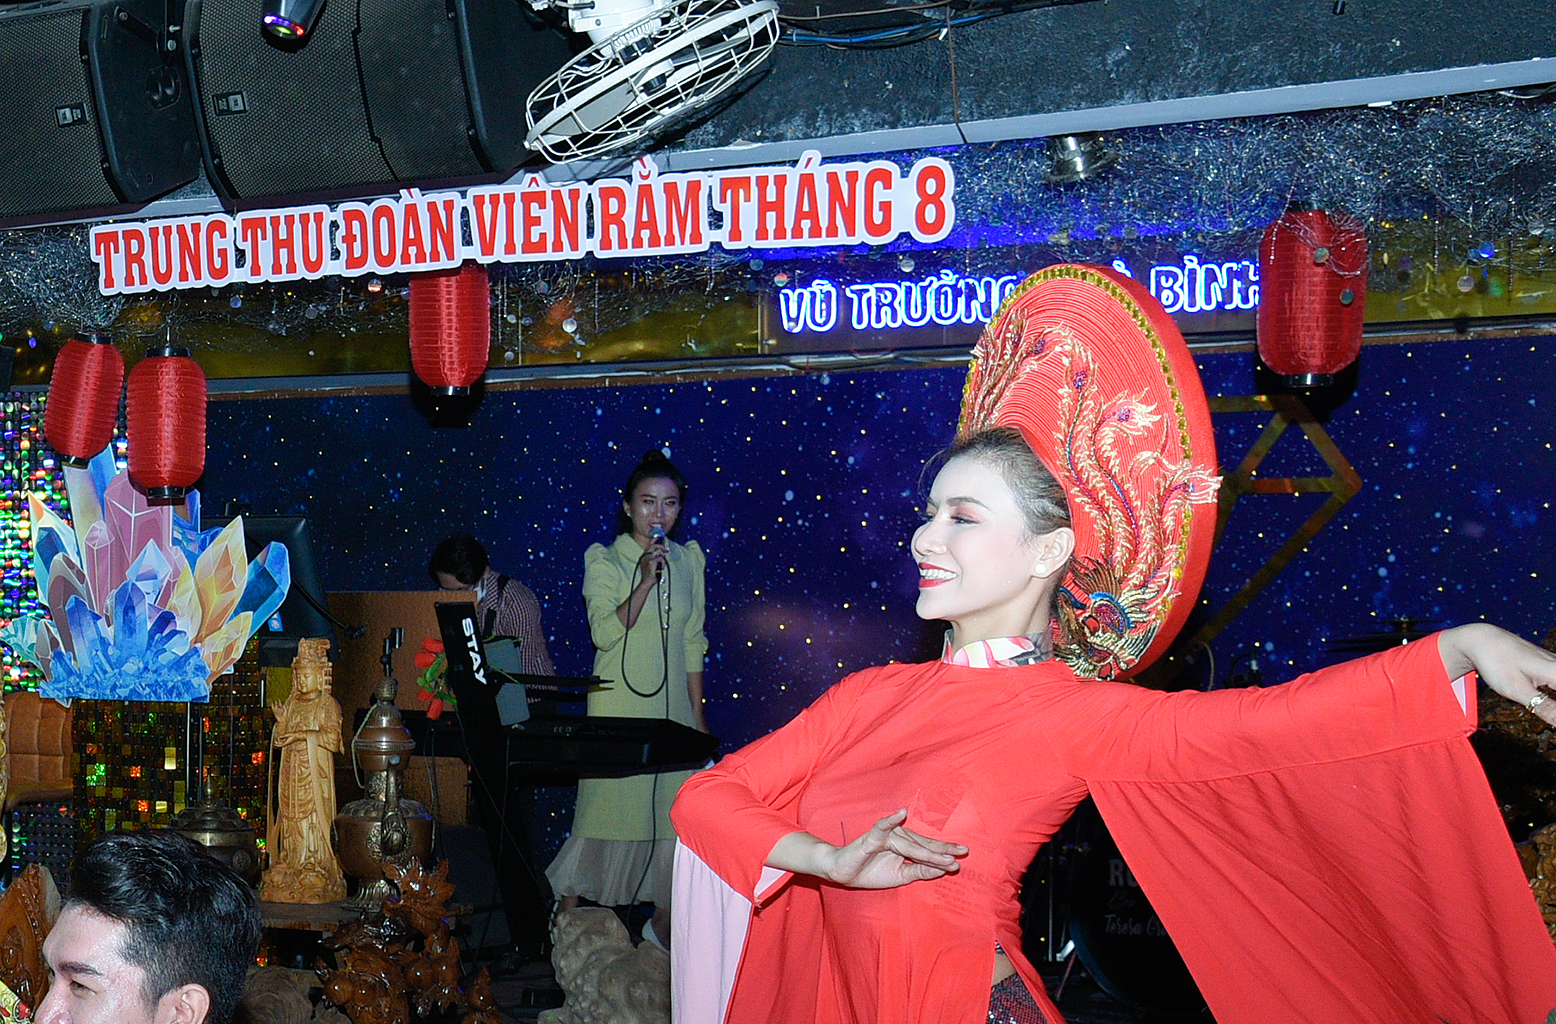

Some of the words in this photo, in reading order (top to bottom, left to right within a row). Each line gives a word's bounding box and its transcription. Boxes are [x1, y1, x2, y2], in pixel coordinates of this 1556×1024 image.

[94, 219, 230, 289] TRUNG
[241, 211, 325, 277] THU
[342, 188, 455, 270] ĐOÀN
[472, 176, 581, 257] VIÊN
[598, 157, 703, 250] RẰM
[719, 157, 893, 242] THÁNG
[915, 165, 946, 236] 8
[462, 617, 488, 686] STAY
